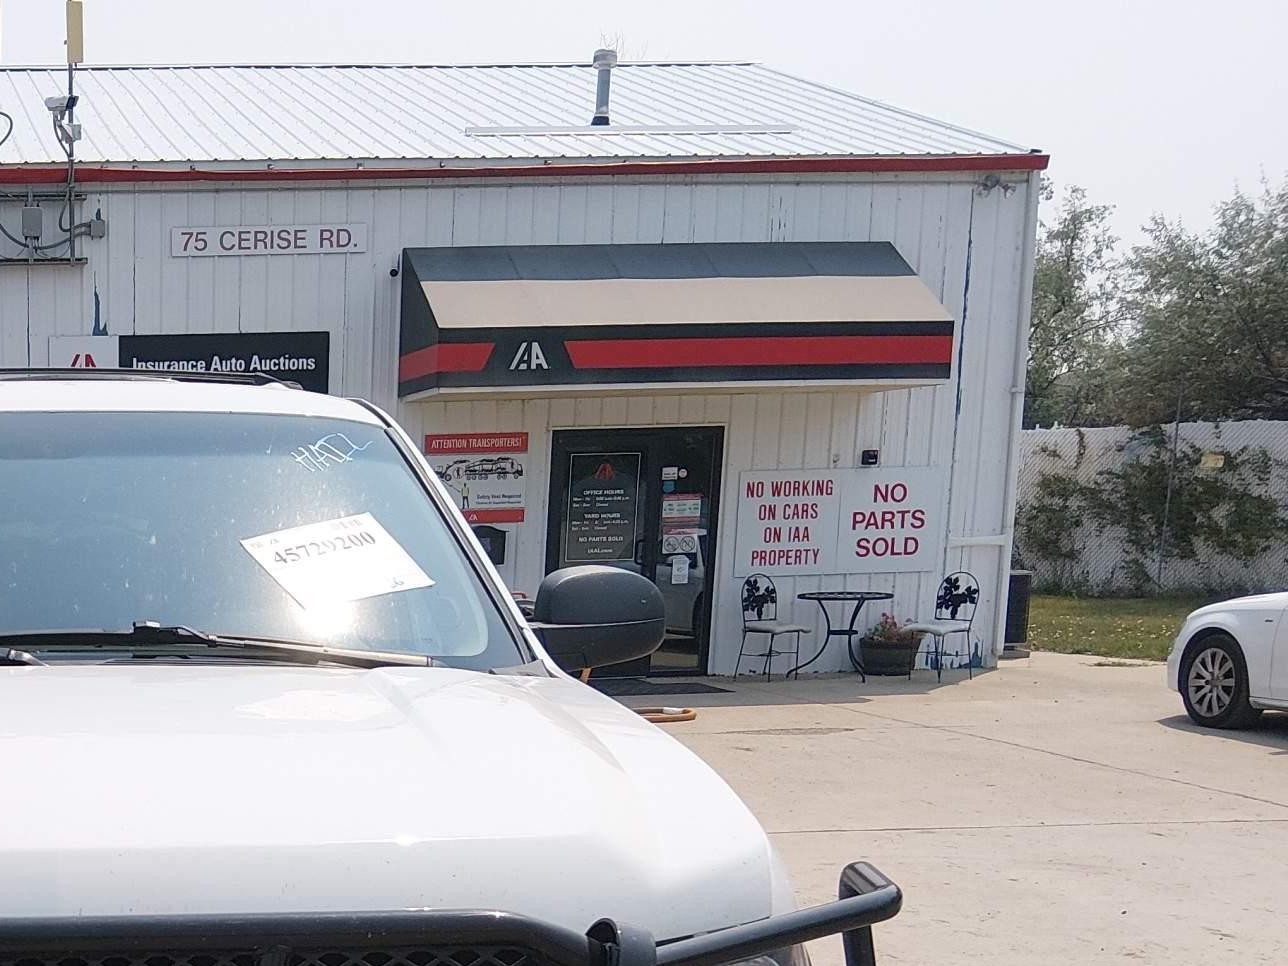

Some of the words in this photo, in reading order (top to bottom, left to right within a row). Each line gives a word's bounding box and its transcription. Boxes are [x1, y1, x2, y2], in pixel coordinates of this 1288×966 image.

[181, 231, 208, 251] 75
[219, 229, 307, 250] CERISE
[319, 228, 358, 249] RD.
[132, 357, 206, 372] Insurance
[210, 355, 246, 373] Auto
[250, 354, 316, 371] Auctions
[431, 439, 467, 449] ATTENTION
[469, 438, 522, 448] TRANSPORTERS!
[746, 481, 765, 498] NO
[771, 479, 833, 497] WORKING
[873, 483, 908, 503] NO
[758, 504, 776, 521] ON
[783, 503, 818, 520] CARS
[852, 509, 926, 531] PARTS
[763, 527, 781, 543] ON
[788, 526, 810, 542] IAA
[855, 537, 919, 558] SOLD
[751, 548, 820, 567] PROPERTY
